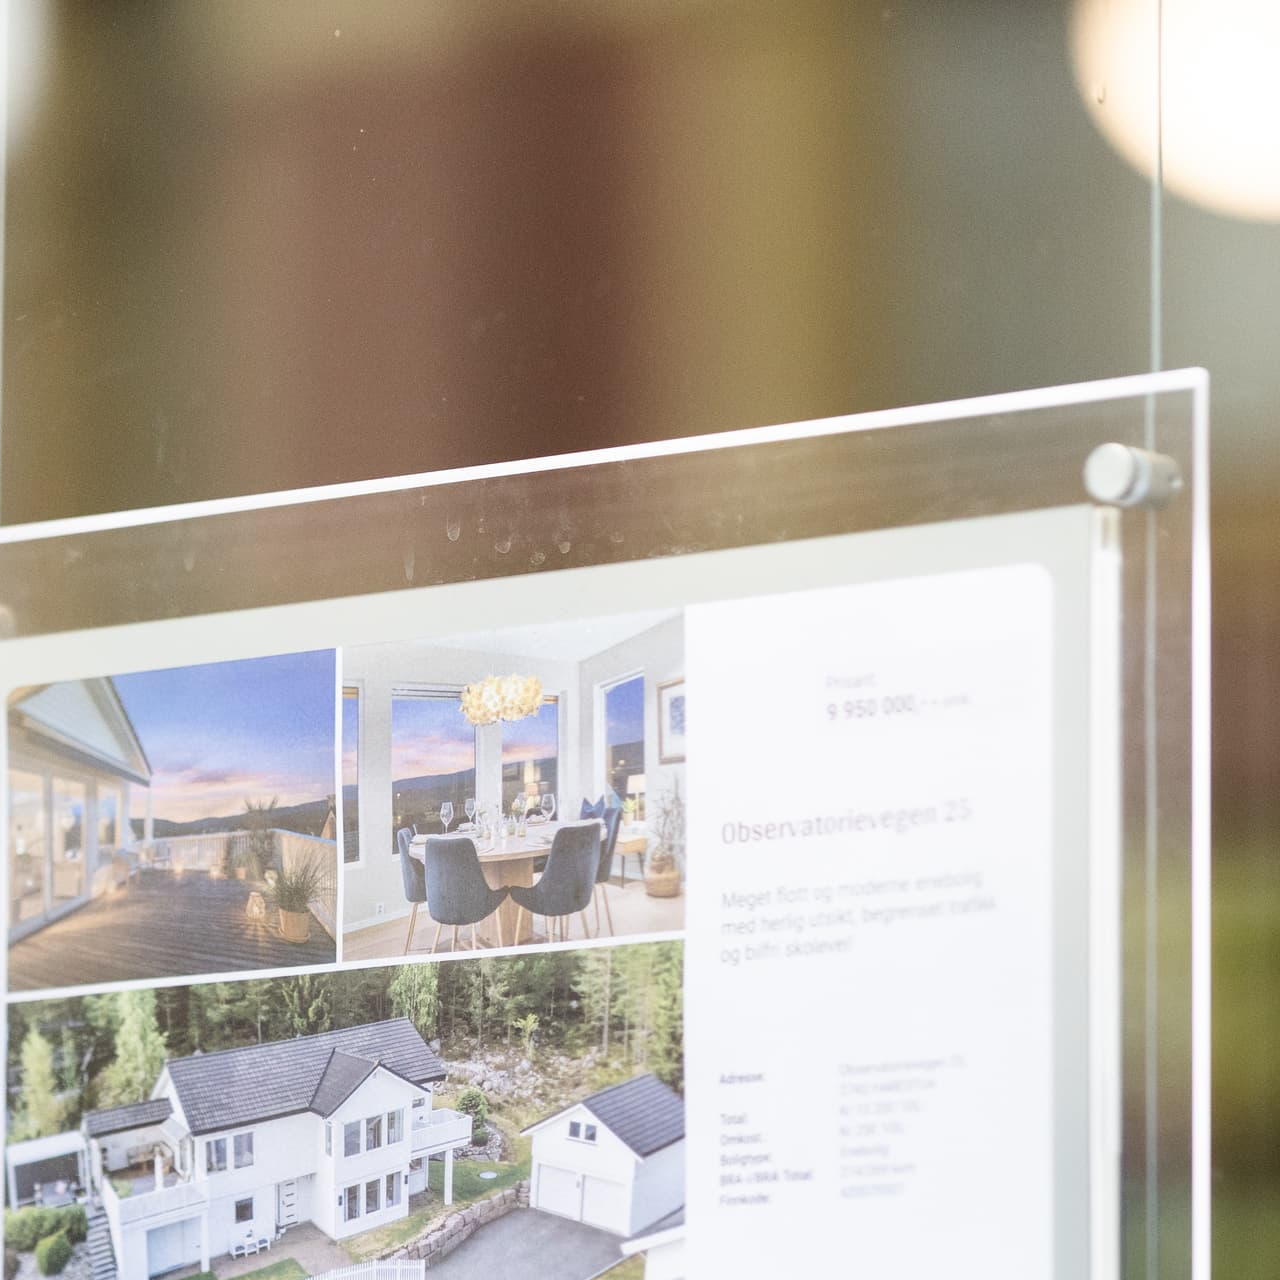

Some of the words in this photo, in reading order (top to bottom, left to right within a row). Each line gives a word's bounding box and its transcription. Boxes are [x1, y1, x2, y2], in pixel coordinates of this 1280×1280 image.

[721, 806, 937, 845] Observatorievegen
[721, 890, 771, 911] Meget
[720, 948, 740, 966] og
